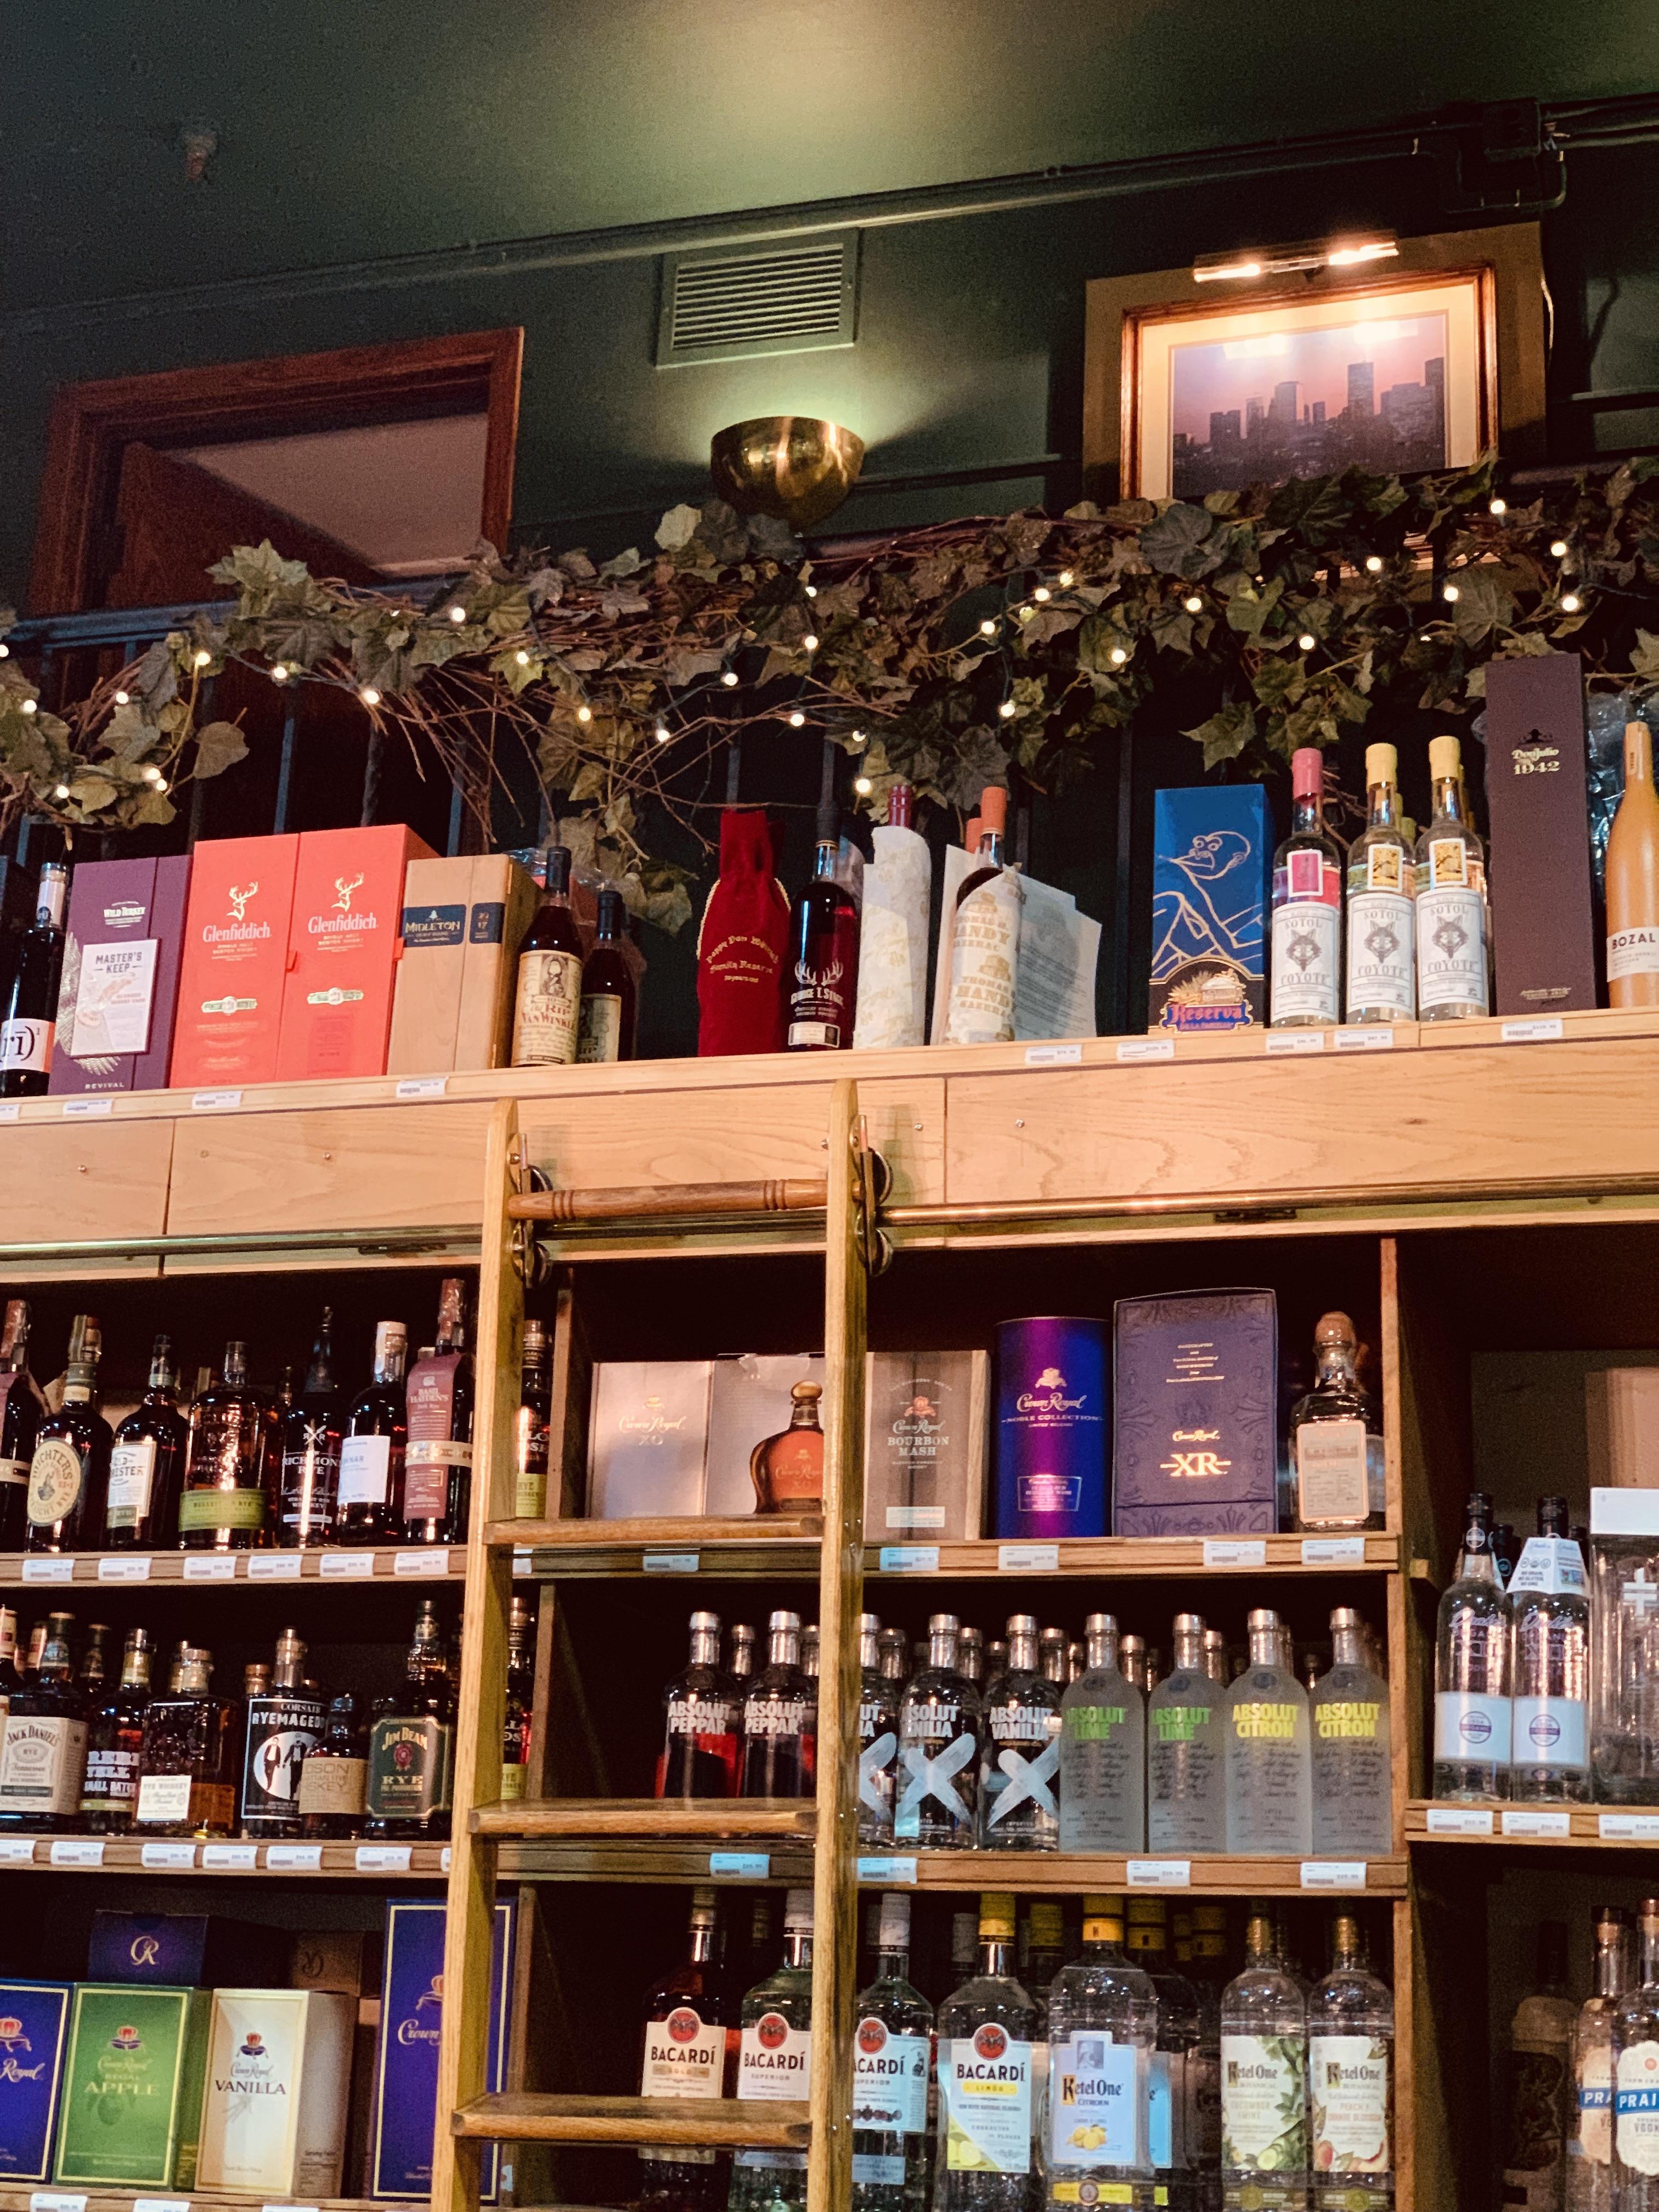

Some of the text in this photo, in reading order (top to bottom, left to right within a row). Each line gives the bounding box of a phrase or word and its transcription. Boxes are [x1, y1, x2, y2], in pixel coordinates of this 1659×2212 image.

[1514, 761, 1560, 775] 1942
[1364, 910, 1402, 921] SOTOL
[1431, 904, 1468, 916] SOTOL
[308, 913, 377, 934] Glenfiddich
[1285, 918, 1323, 929] SOTOL
[202, 922, 271, 943] Glenfiddich
[1611, 933, 1656, 950] BOZAL
[95, 952, 143, 964] MASTER'S
[1428, 960, 1475, 973] COYOTE
[106, 963, 131, 974] KEEP
[1358, 964, 1406, 978] COYOTE
[1282, 973, 1329, 986] COYOTE
[545, 1004, 571, 1015] RIP
[1169, 1003, 1242, 1025] Reserva
[1017, 1392, 1087, 1412] Crown Royal
[619, 1415, 687, 1432] Crown Royal
[893, 1419, 946, 1434] Crown Royal
[638, 1435, 663, 1446] XO
[887, 1436, 950, 1446] BOURBON
[899, 1447, 936, 1456] MASH
[298, 1466, 325, 1475] RE
[799, 1464, 823, 1480] Roya
[1170, 1452, 1223, 1477] XR
[280, 1702, 321, 1714] CORSAIR
[668, 1700, 732, 1720] ABSOLUT
[743, 1700, 805, 1720] ABSOLUT
[989, 1706, 1054, 1724] ABSOLUT
[1232, 1703, 1299, 1723] ABSOLUT
[1314, 1703, 1380, 1722] ABSOLUT
[670, 1717, 726, 1736] PEPPAR
[744, 1717, 799, 1735] PEPPAR
[1074, 1722, 1110, 1741] LIME
[1159, 1723, 1194, 1741] LIME
[1236, 1720, 1295, 1738] CITRON
[1318, 1720, 1376, 1738] CITRON
[7, 1728, 27, 1746] JACK
[382, 1726, 428, 1751] JIM BEAM
[306, 1763, 350, 1774] DSON
[382, 1775, 424, 1784] RYE
[397, 2018, 441, 2045] Crown
[651, 2045, 716, 2065] BACARDÍ
[744, 2051, 805, 2070] BACARDÍ
[0, 2059, 46, 2083] Royal
[854, 2055, 905, 2075] CARDÍ
[956, 2062, 1025, 2082] BACARDÍ
[1255, 2064, 1278, 2080] One
[1359, 2065, 1381, 2080] One
[751, 2073, 791, 2081] SUPERIOR
[84, 2081, 160, 2097] APPLE
[215, 2079, 286, 2095] VANILLA
[1063, 2075, 1123, 2103] Ketel One
[1078, 2098, 1110, 2107] CITROEN
